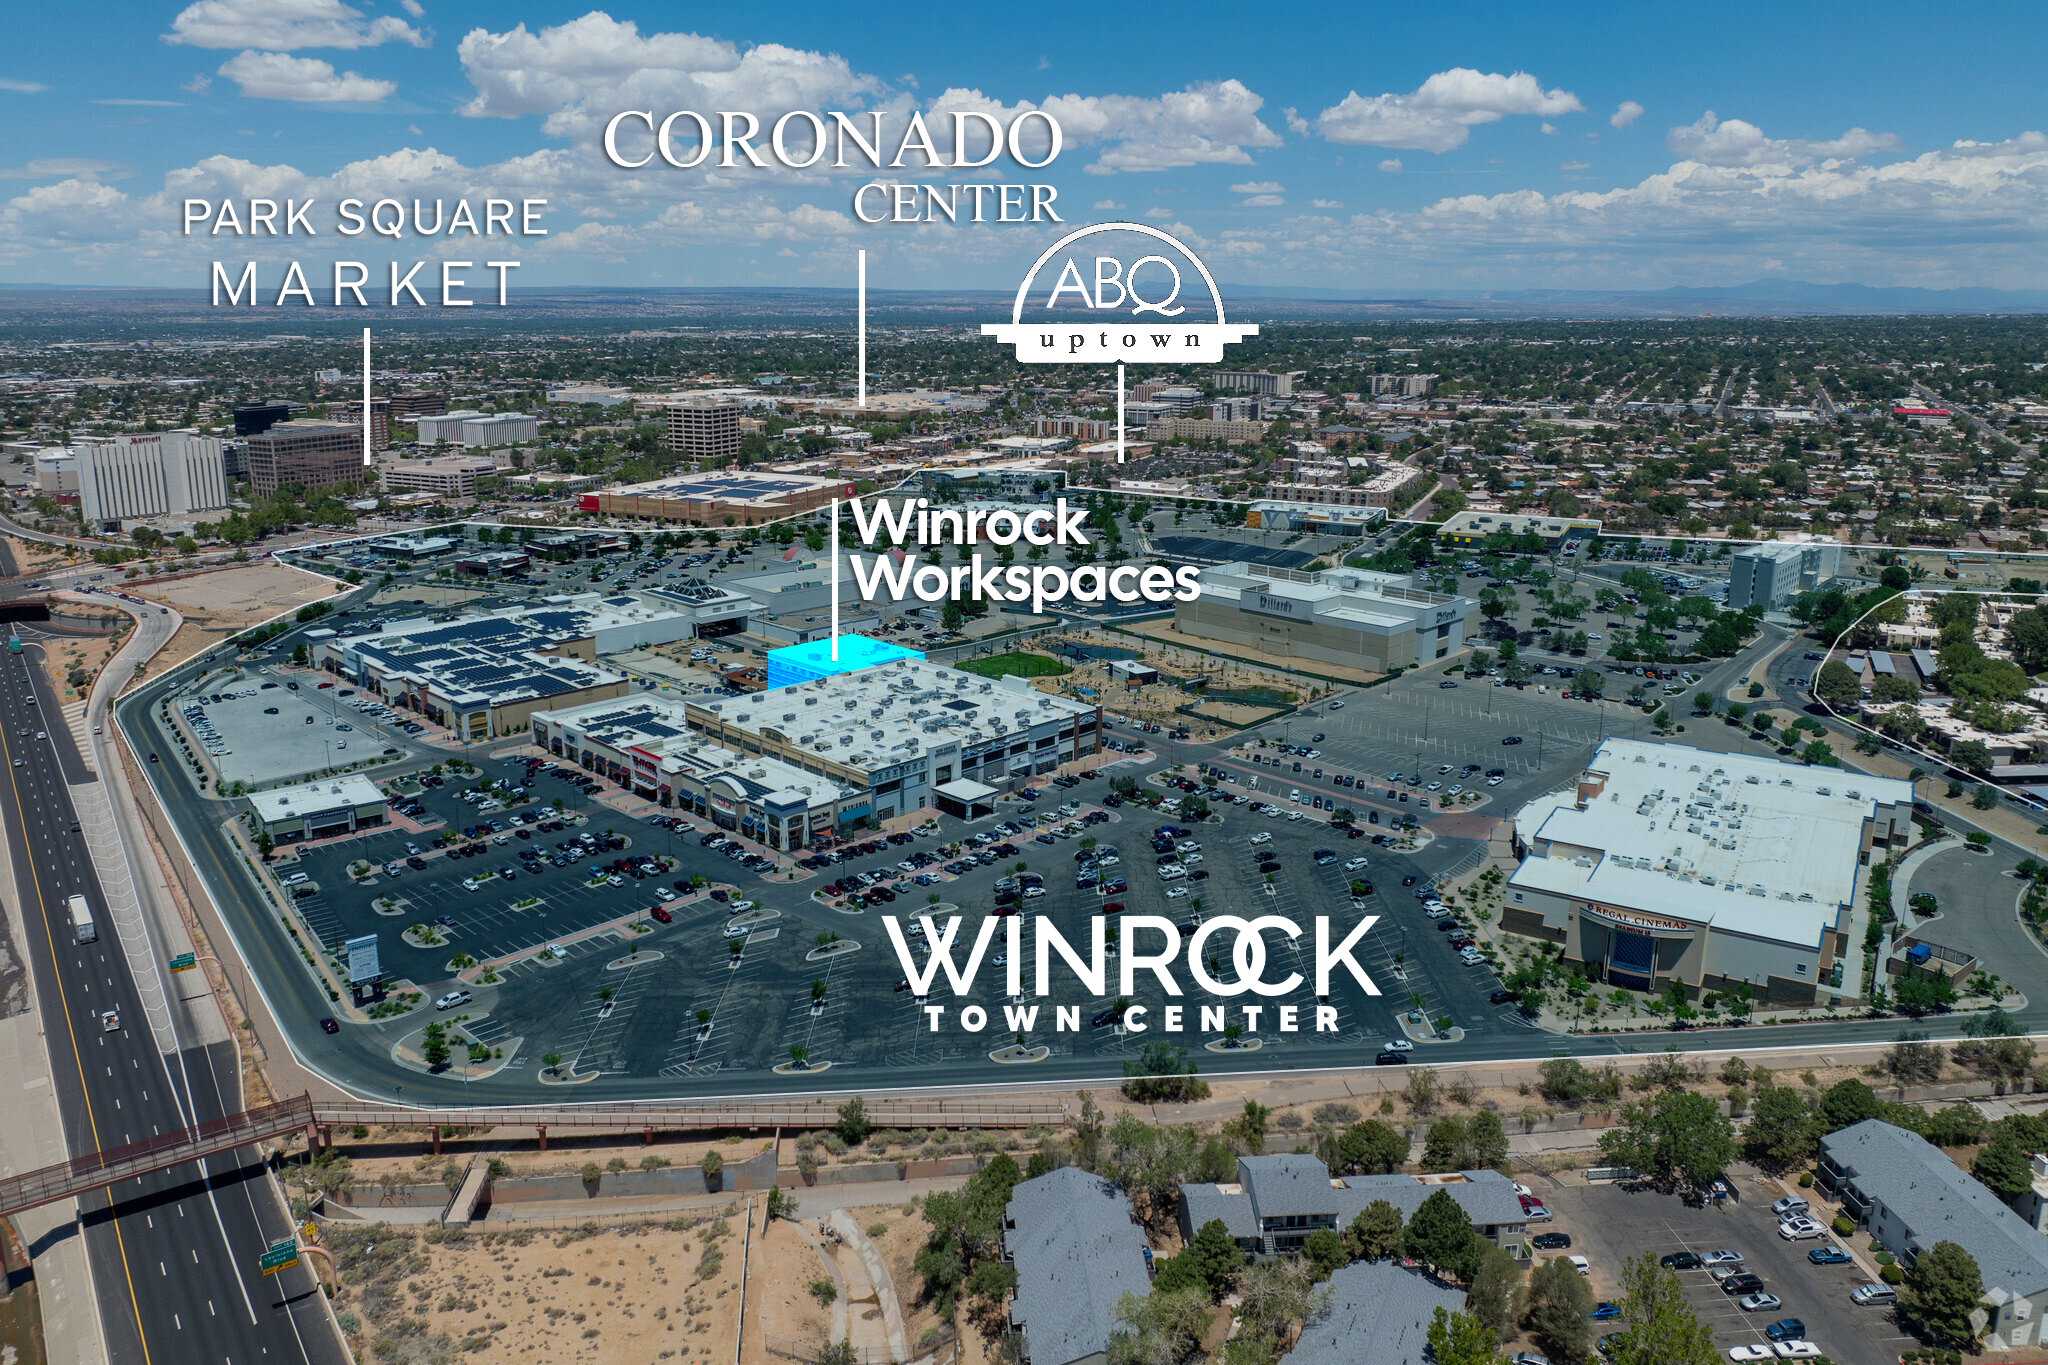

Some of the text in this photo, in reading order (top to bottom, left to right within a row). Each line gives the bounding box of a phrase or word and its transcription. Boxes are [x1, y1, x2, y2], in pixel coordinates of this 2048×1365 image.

[130, 435, 161, 446] Marriott
[1595, 906, 1688, 930] REGAL CINEMAS
[264, 1248, 294, 1262] Louisiana
